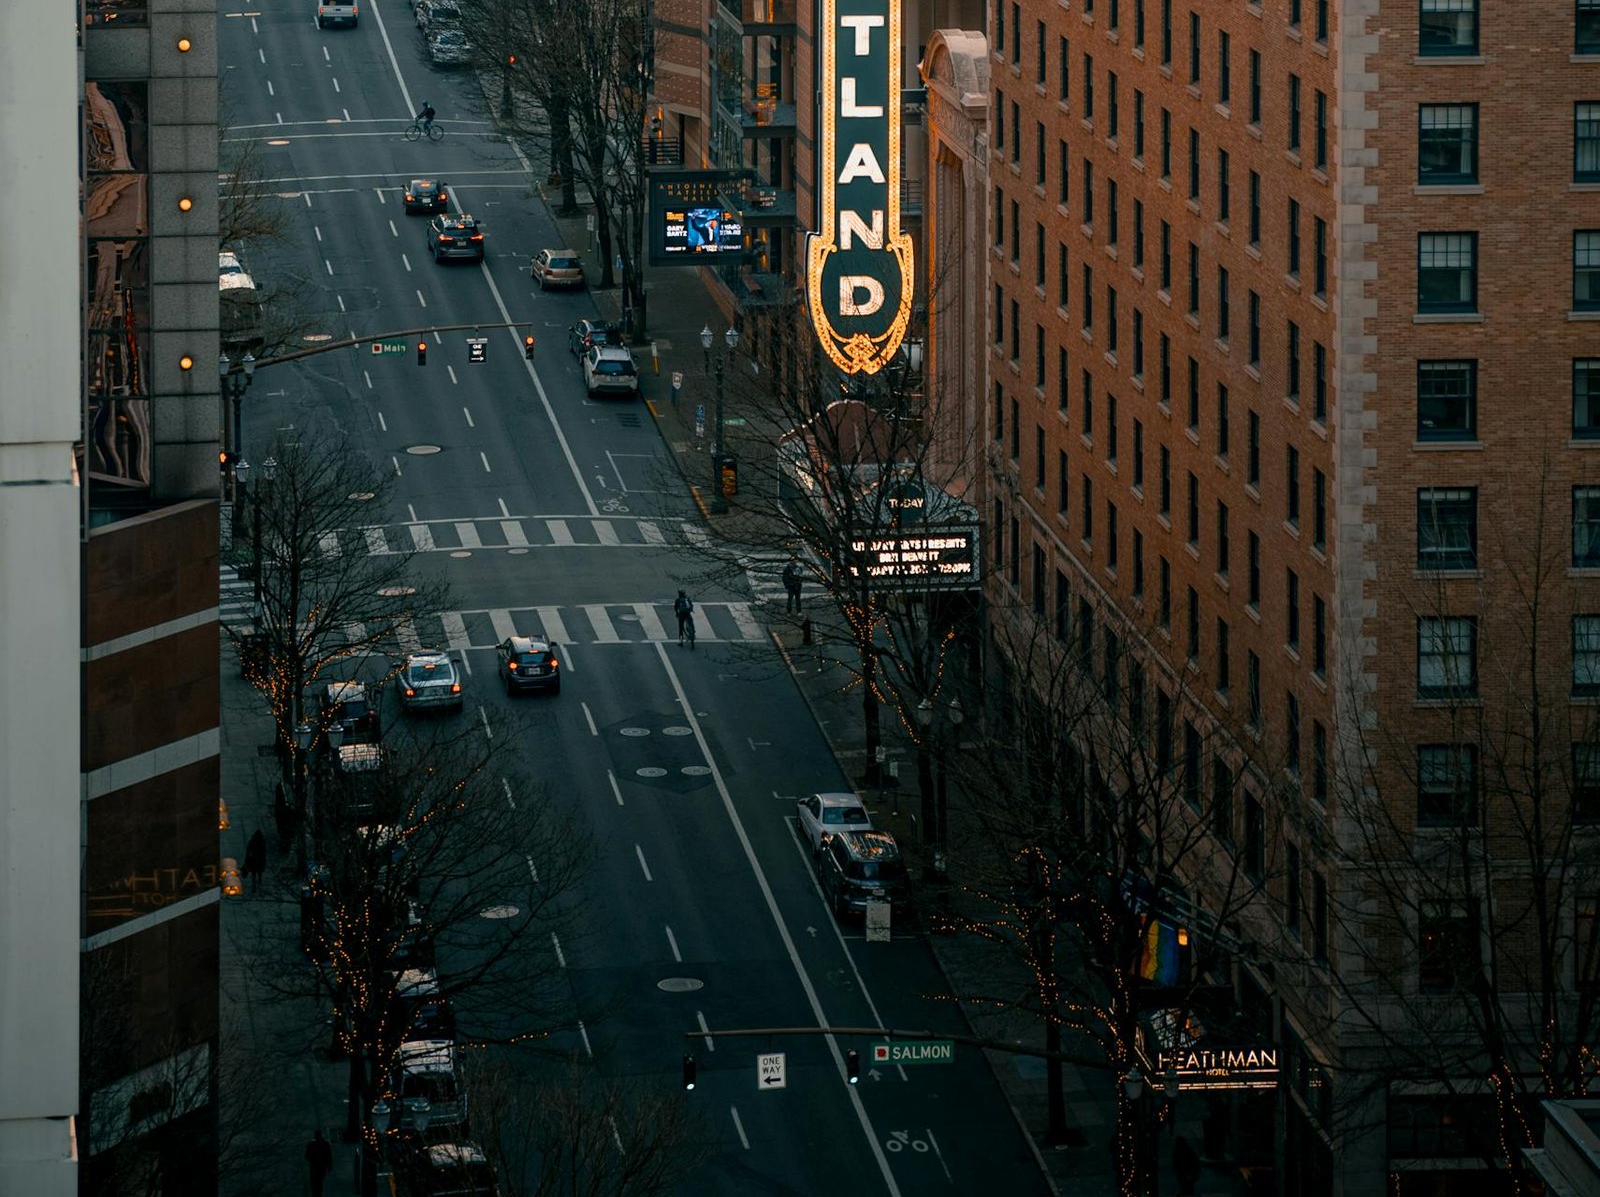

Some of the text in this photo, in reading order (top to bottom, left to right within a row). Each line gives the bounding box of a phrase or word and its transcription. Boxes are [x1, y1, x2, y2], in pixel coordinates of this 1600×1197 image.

[383, 343, 406, 353] Main
[891, 1044, 951, 1060] SALMON
[762, 1057, 780, 1066] ONE
[1157, 1049, 1277, 1069] HEATHMAN
[762, 1065, 781, 1074] WAY
[1205, 1068, 1230, 1077] HOTEL
